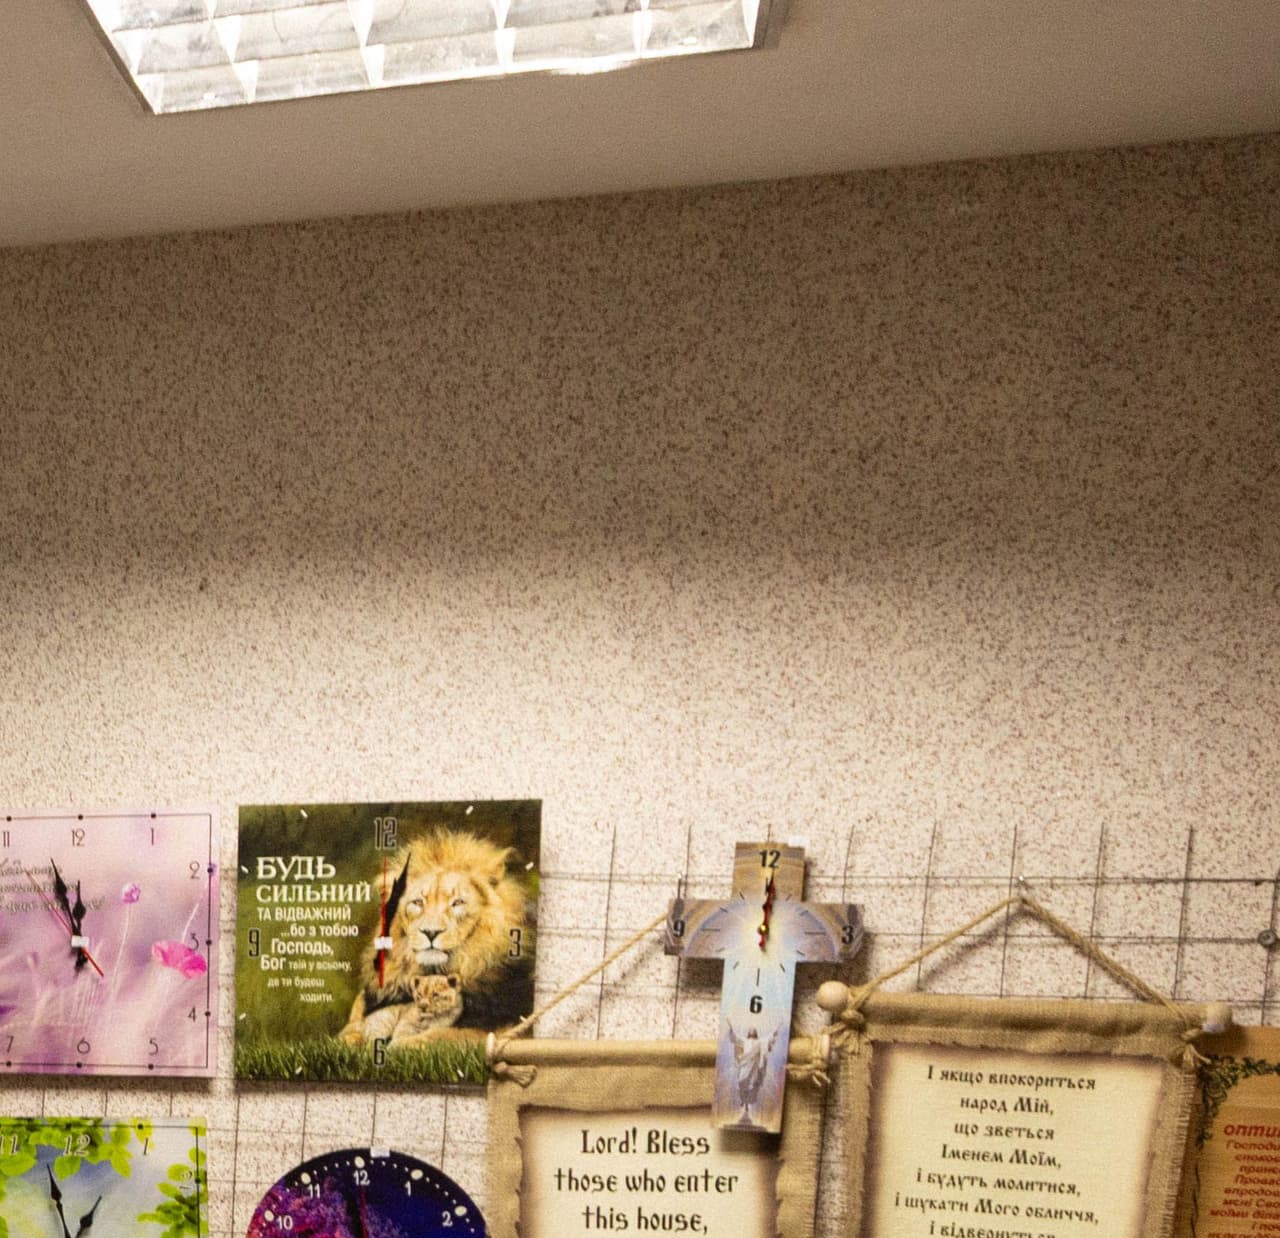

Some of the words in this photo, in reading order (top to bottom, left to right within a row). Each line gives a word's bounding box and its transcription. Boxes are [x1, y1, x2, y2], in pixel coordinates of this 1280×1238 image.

[374, 817, 397, 850] 12
[256, 855, 336, 881] БУДЬ
[759, 850, 780, 868] 12
[256, 882, 371, 902] СИЛЬНИЙ
[257, 908, 272, 921] ТА
[275, 906, 351, 922] ВІДВАЖНИЙ
[320, 924, 359, 938] тобою
[672, 920, 686, 938] 9
[842, 924, 854, 944] 3
[270, 938, 334, 956] Господь,
[749, 995, 763, 1014] 6
[960, 1096, 1007, 1114] народ
[581, 1128, 637, 1155] Lord!
[646, 1129, 711, 1155] Bless
[554, 1168, 619, 1193] those
[625, 1170, 666, 1193] who
[674, 1168, 739, 1193] enter
[582, 1206, 629, 1231] this
[636, 1206, 708, 1234] house,
